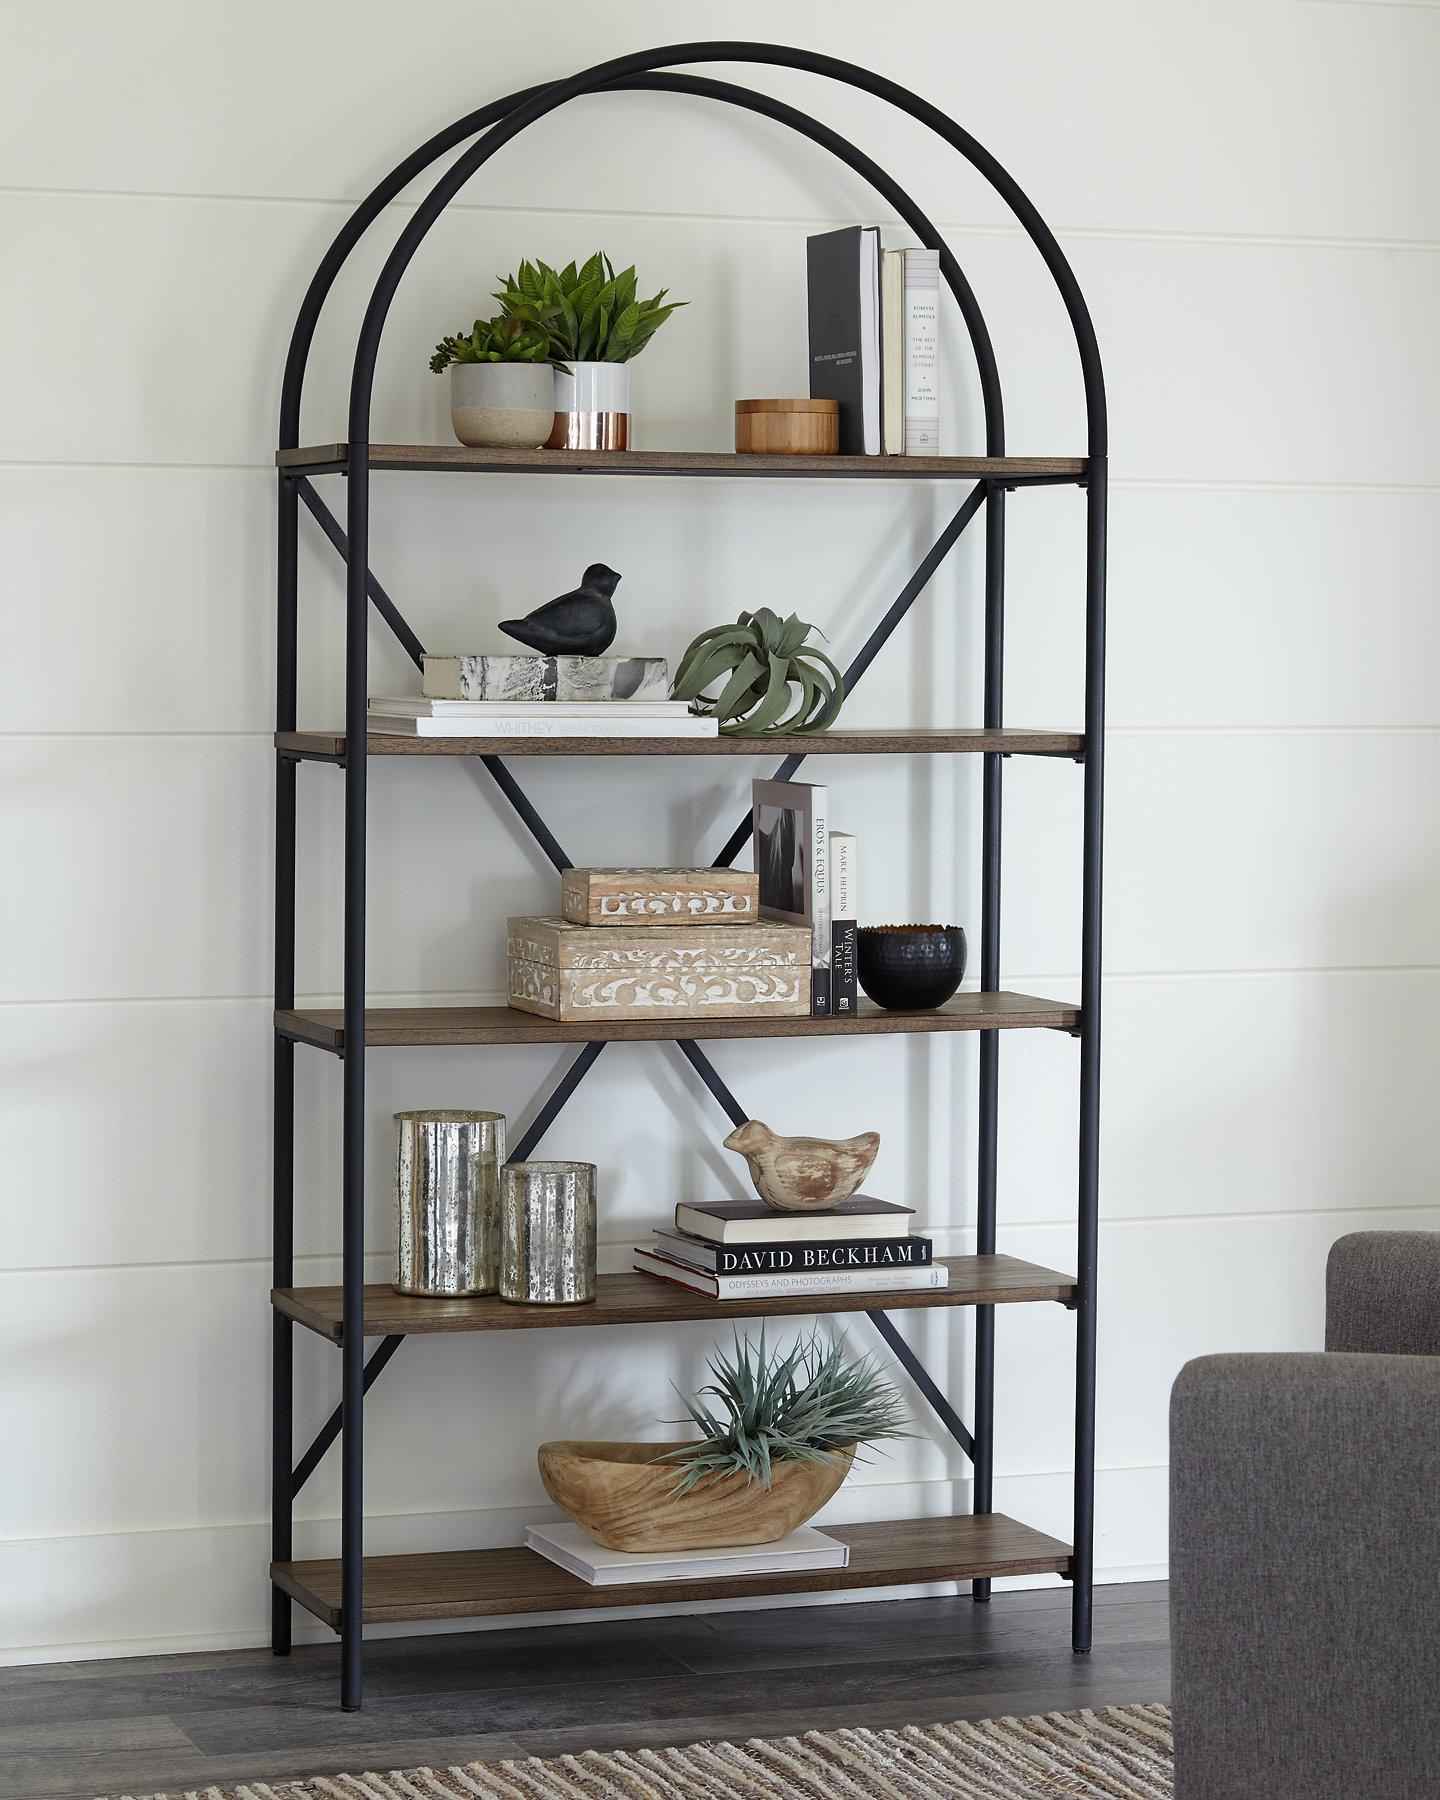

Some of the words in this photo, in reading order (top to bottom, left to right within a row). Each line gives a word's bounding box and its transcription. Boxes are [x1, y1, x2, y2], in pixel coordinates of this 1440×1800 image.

[815, 817, 825, 845] EROS
[815, 847, 825, 856] &
[839, 845, 848, 873] MARK
[814, 859, 825, 896] EQUUS
[839, 876, 848, 912] HELPRIN
[835, 942, 844, 969] TALE
[844, 928, 854, 984] WINTER'S
[723, 1250, 794, 1270] DAVID
[803, 1245, 913, 1266] BECKHAM
[729, 1279, 769, 1289] ODYSSEYS
[771, 1278, 790, 1288] AND
[791, 1275, 852, 1288] PHOTOGRAPHS
